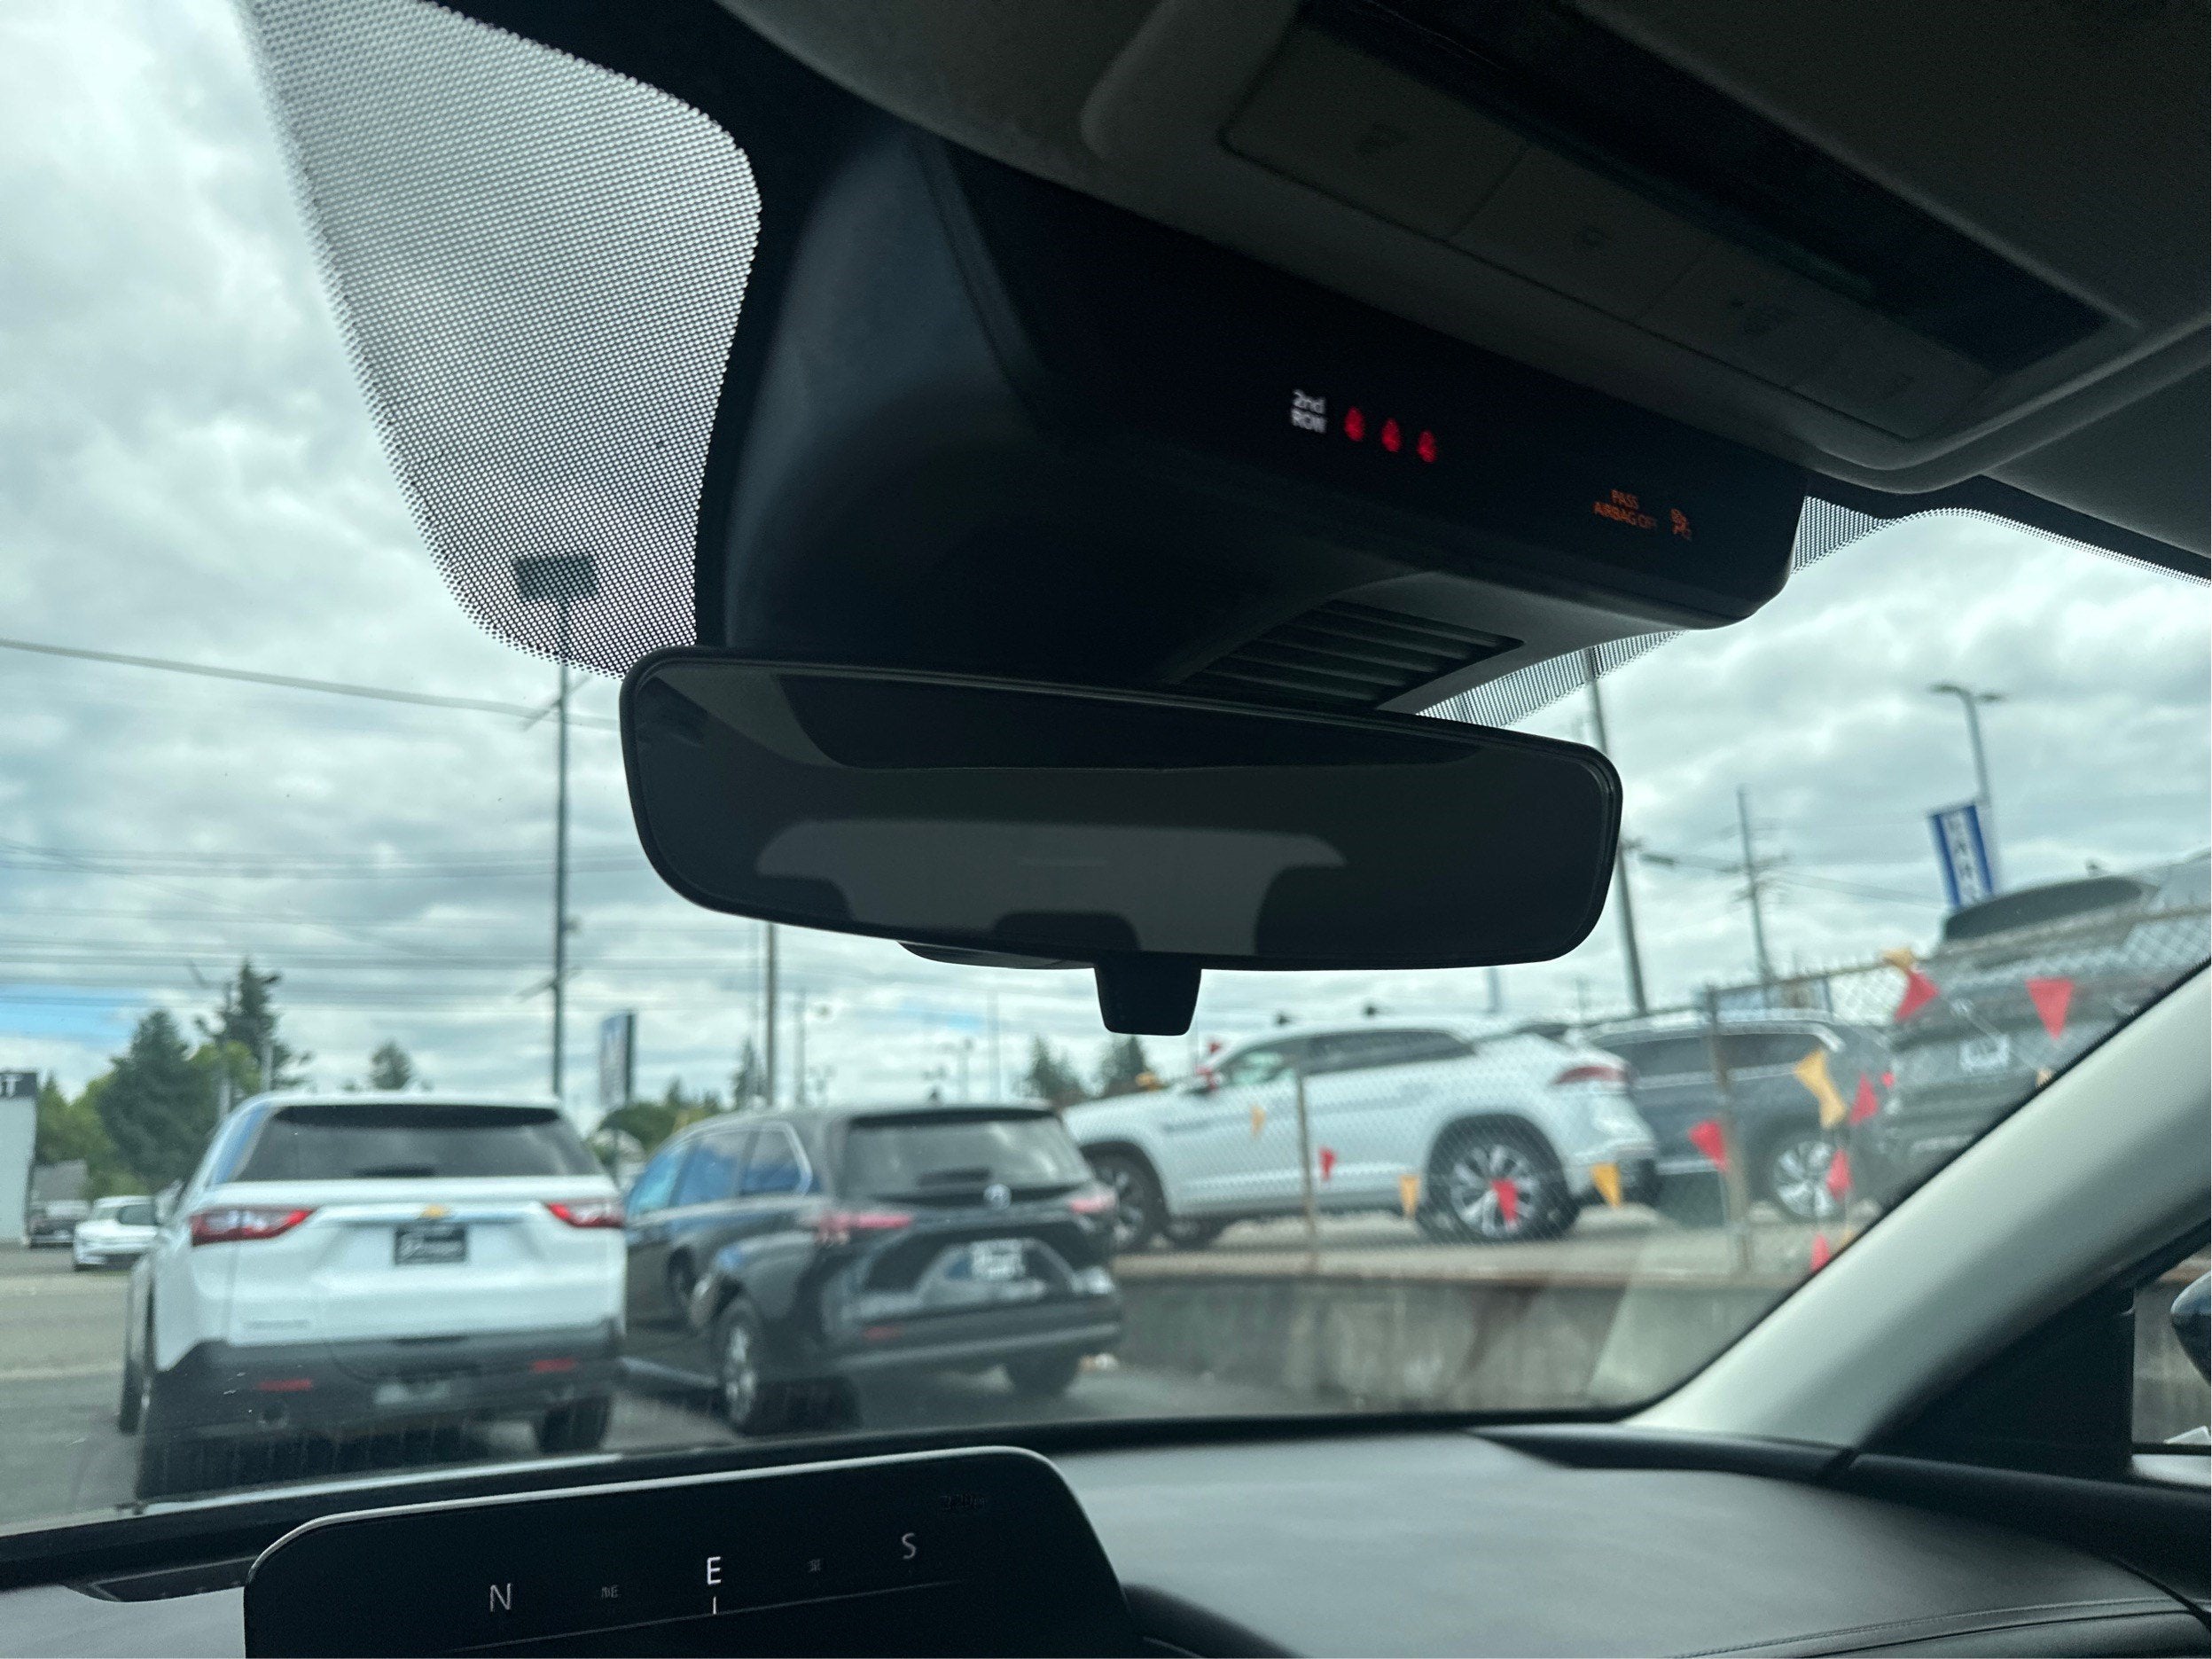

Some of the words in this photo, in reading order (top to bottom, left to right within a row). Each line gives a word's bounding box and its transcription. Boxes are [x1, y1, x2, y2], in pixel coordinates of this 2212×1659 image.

[1293, 389, 1325, 414] 2nd
[1611, 489, 1638, 511] PASS
[1593, 502, 1637, 526] AIRBAG
[489, 1582, 512, 1612] N
[706, 1555, 722, 1585] E
[901, 1532, 917, 1560] S
